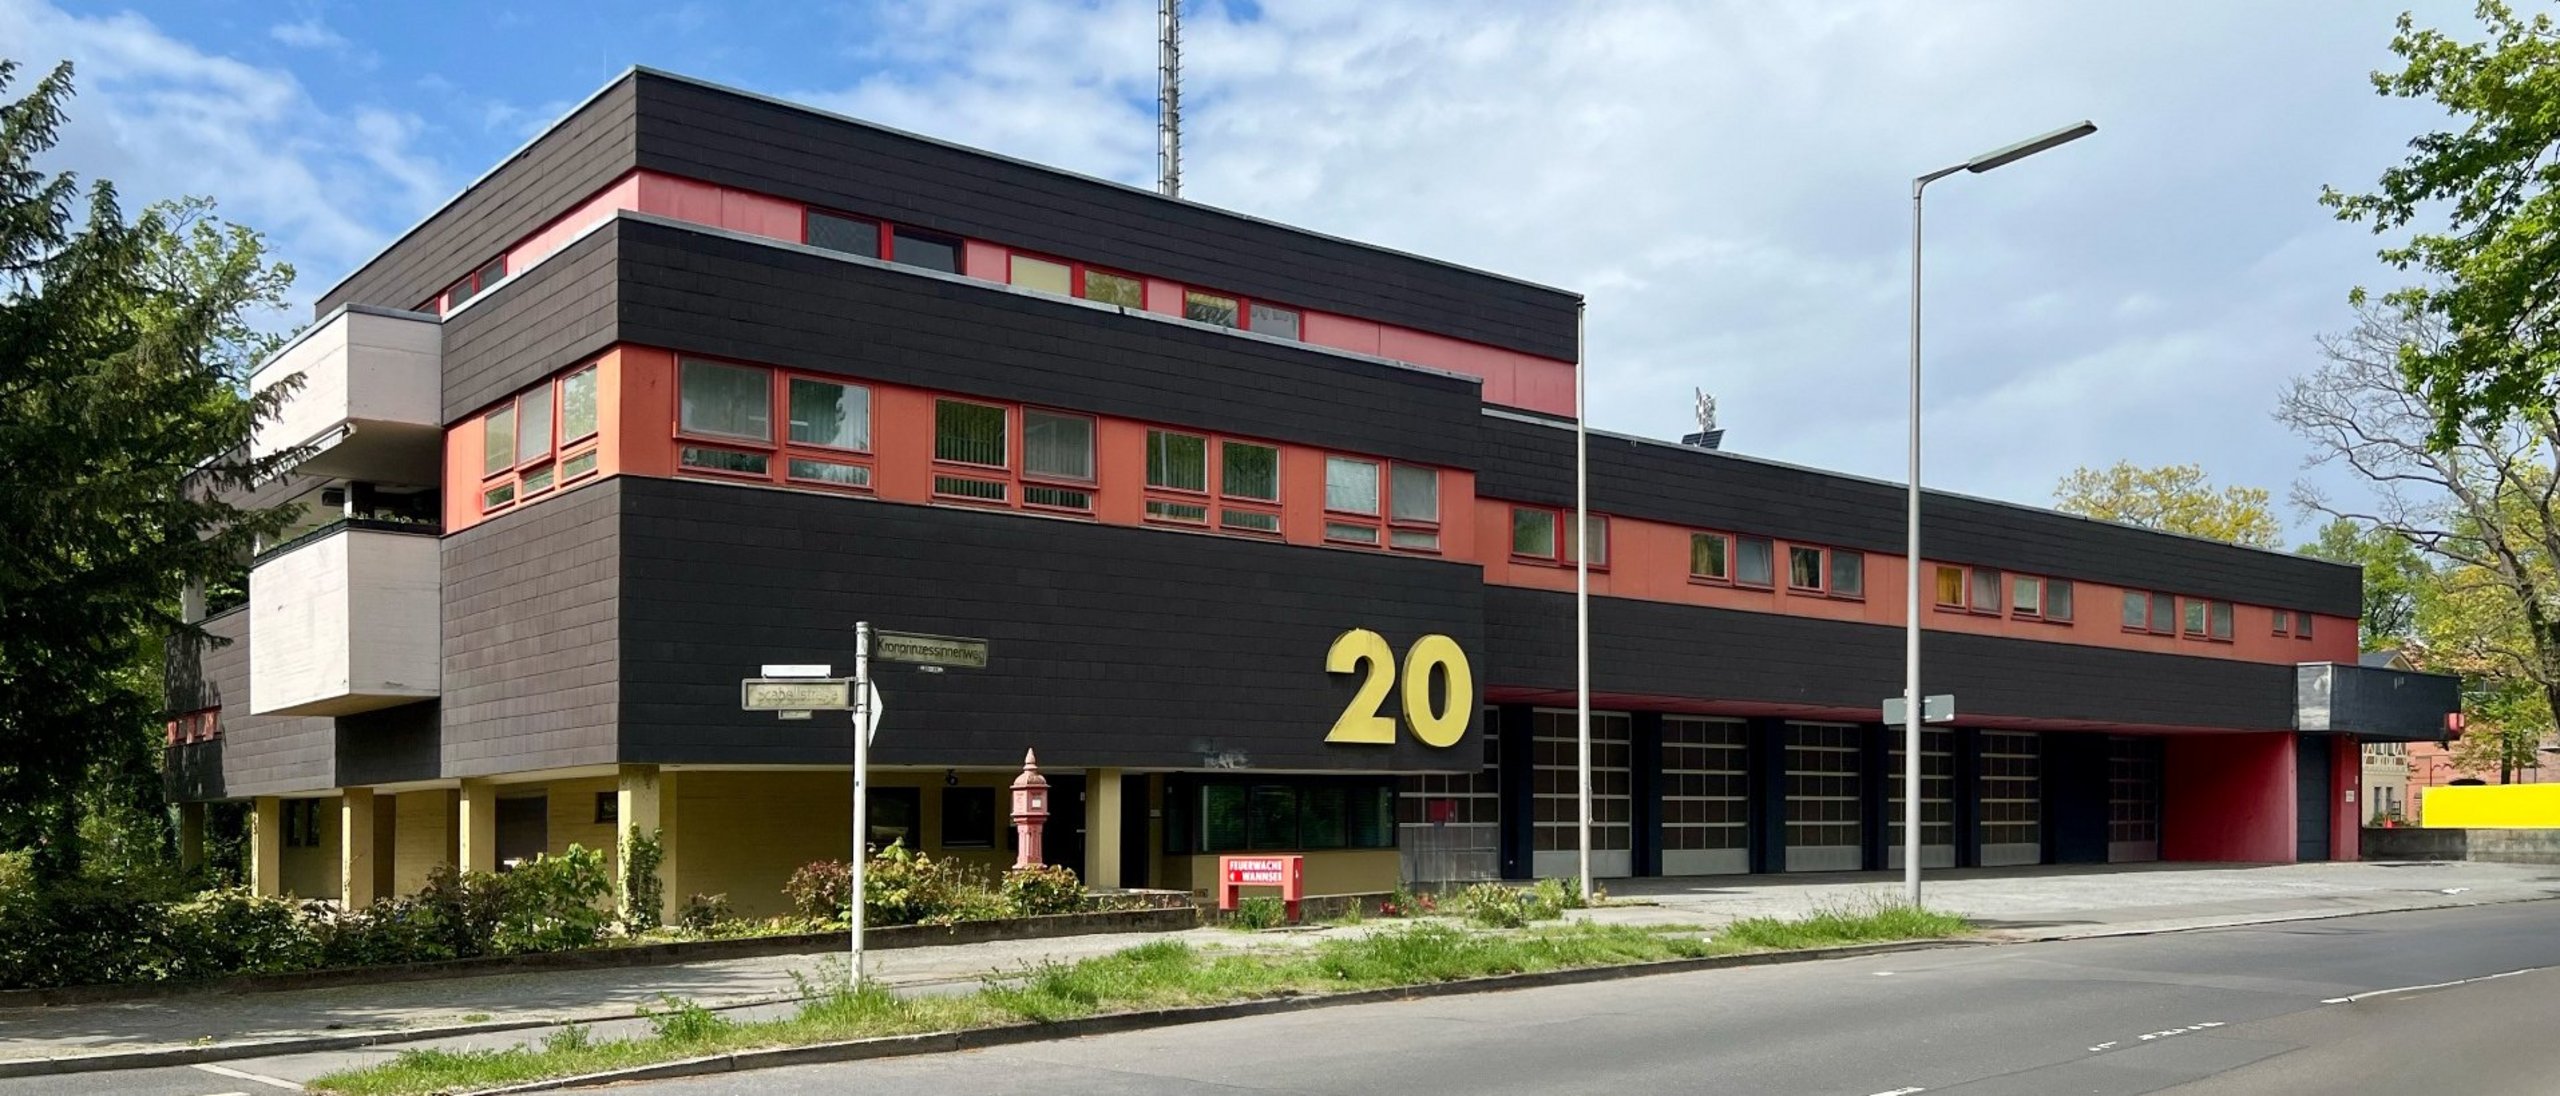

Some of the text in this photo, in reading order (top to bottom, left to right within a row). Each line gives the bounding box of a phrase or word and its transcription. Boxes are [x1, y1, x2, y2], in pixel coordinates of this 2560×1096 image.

[1324, 628, 1474, 748] 20
[1229, 861, 1282, 871] FEUERWACHE
[1242, 872, 1282, 882] WANNSEE
